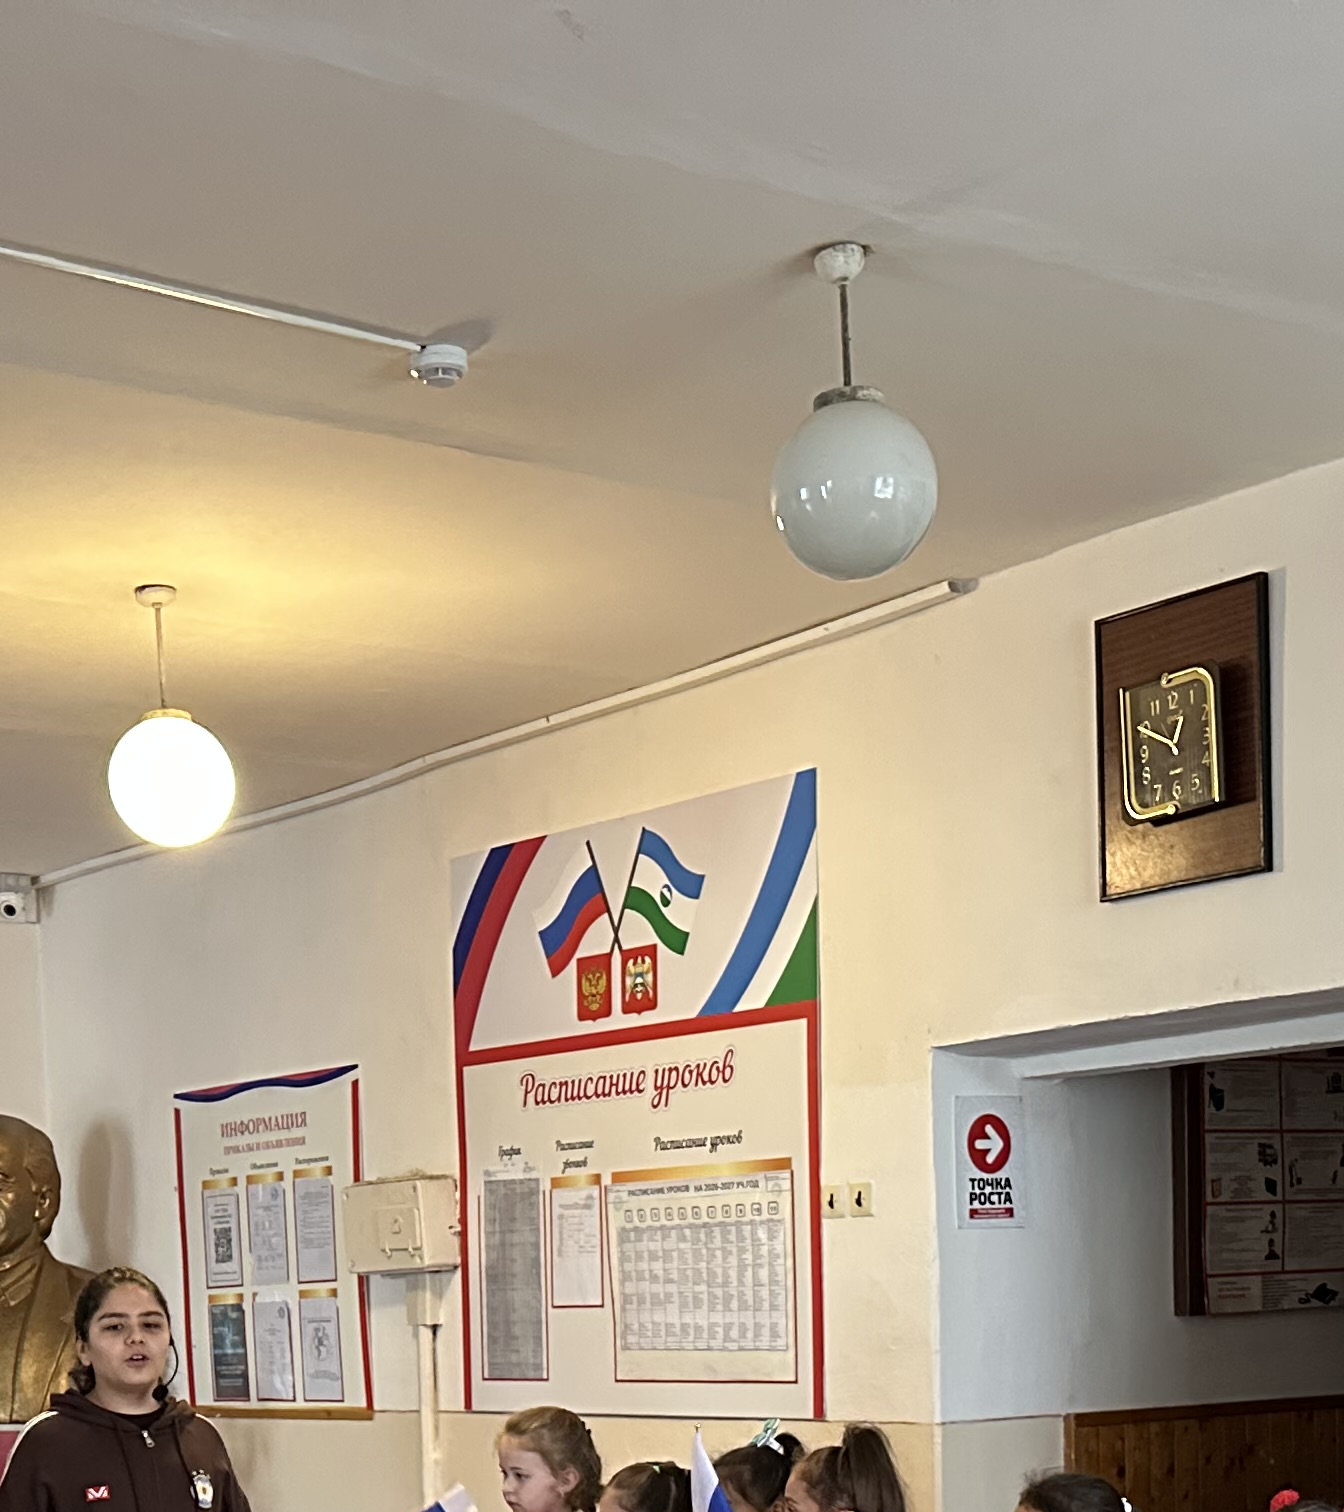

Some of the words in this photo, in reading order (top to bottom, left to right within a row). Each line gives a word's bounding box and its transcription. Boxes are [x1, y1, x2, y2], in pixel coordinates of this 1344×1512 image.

[1167, 690, 1179, 710] 12
[1189, 688, 1195, 705] 1
[1150, 699, 1160, 717] 11
[1139, 744, 1149, 764] 9
[1141, 766, 1151, 785] 8
[1153, 783, 1163, 802] 7
[1172, 780, 1182, 801] 6
[520, 1068, 647, 1108] Расписание
[650, 1047, 735, 1110] уроков
[220, 1111, 307, 1138] ИНФОРМАЦИЯ
[654, 1134, 707, 1152] Расписание
[708, 1129, 743, 1154] уроков
[968, 1177, 1012, 1190] ТОЧКА
[969, 1191, 1013, 1206] РОСТА
